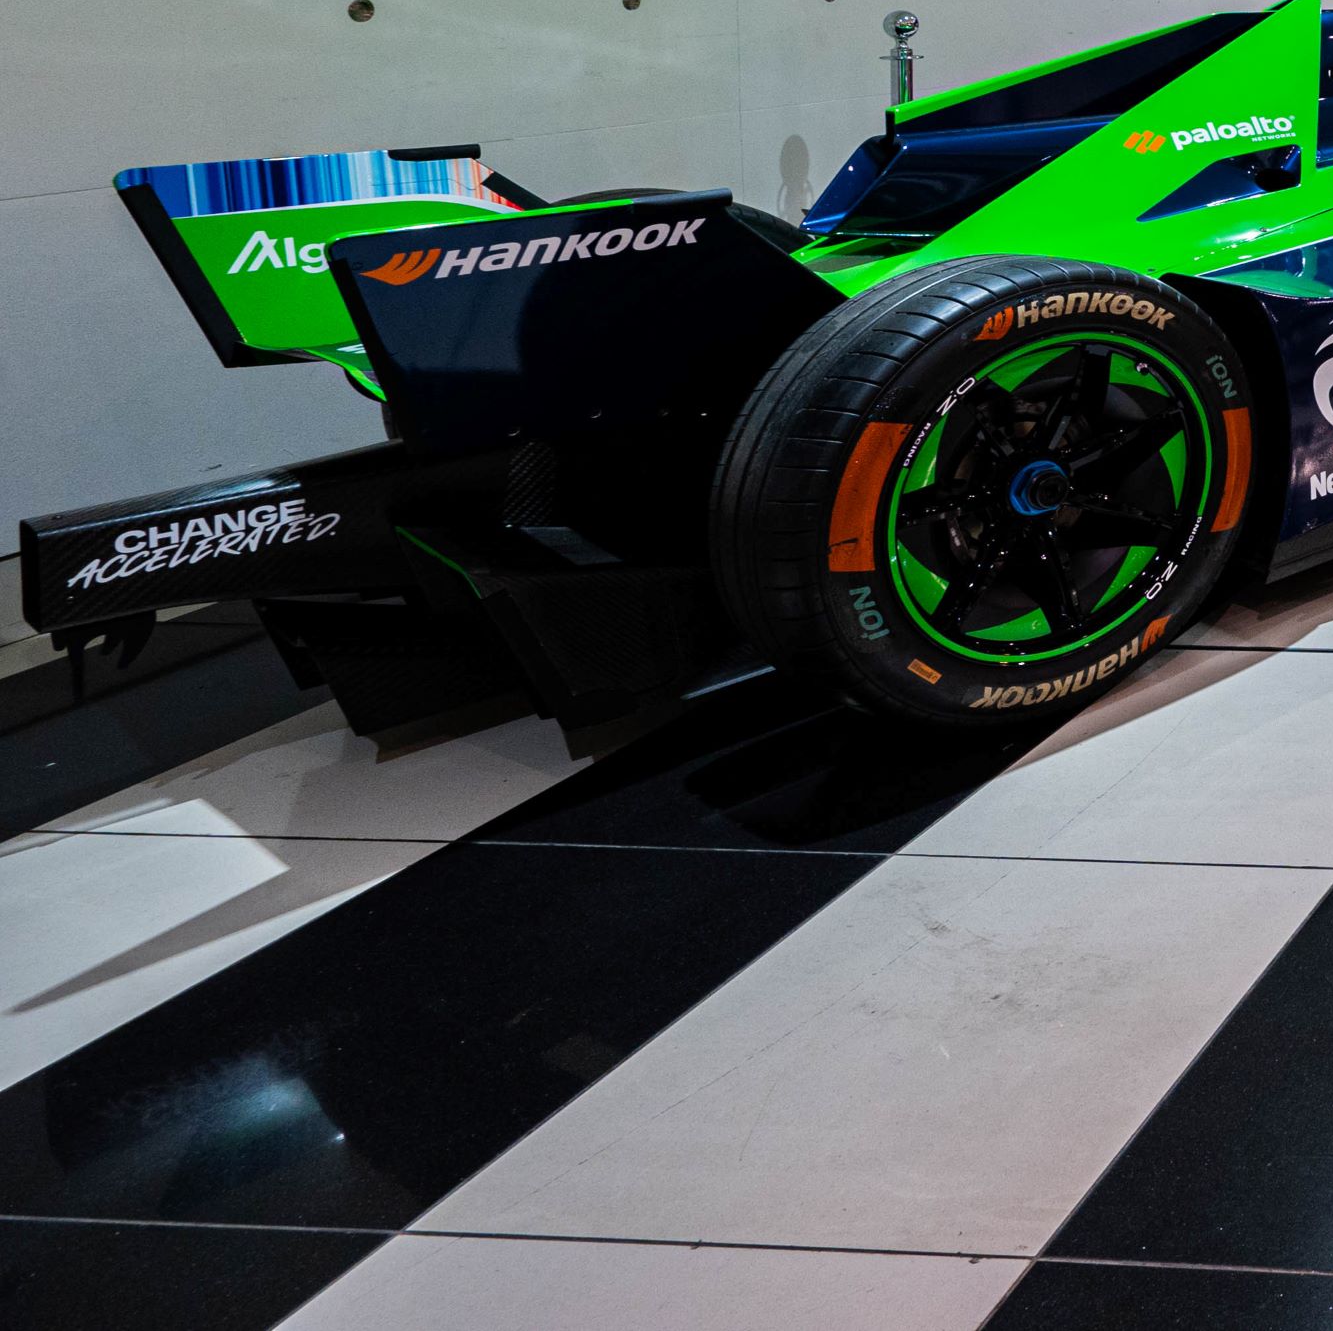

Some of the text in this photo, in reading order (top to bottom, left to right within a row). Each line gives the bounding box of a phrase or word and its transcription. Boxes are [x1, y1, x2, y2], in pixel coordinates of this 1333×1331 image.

[1251, 132, 1296, 142] NETWORKS
[227, 231, 329, 274] Alg
[903, 422, 931, 467] RACING
[1181, 516, 1203, 556] RACING
